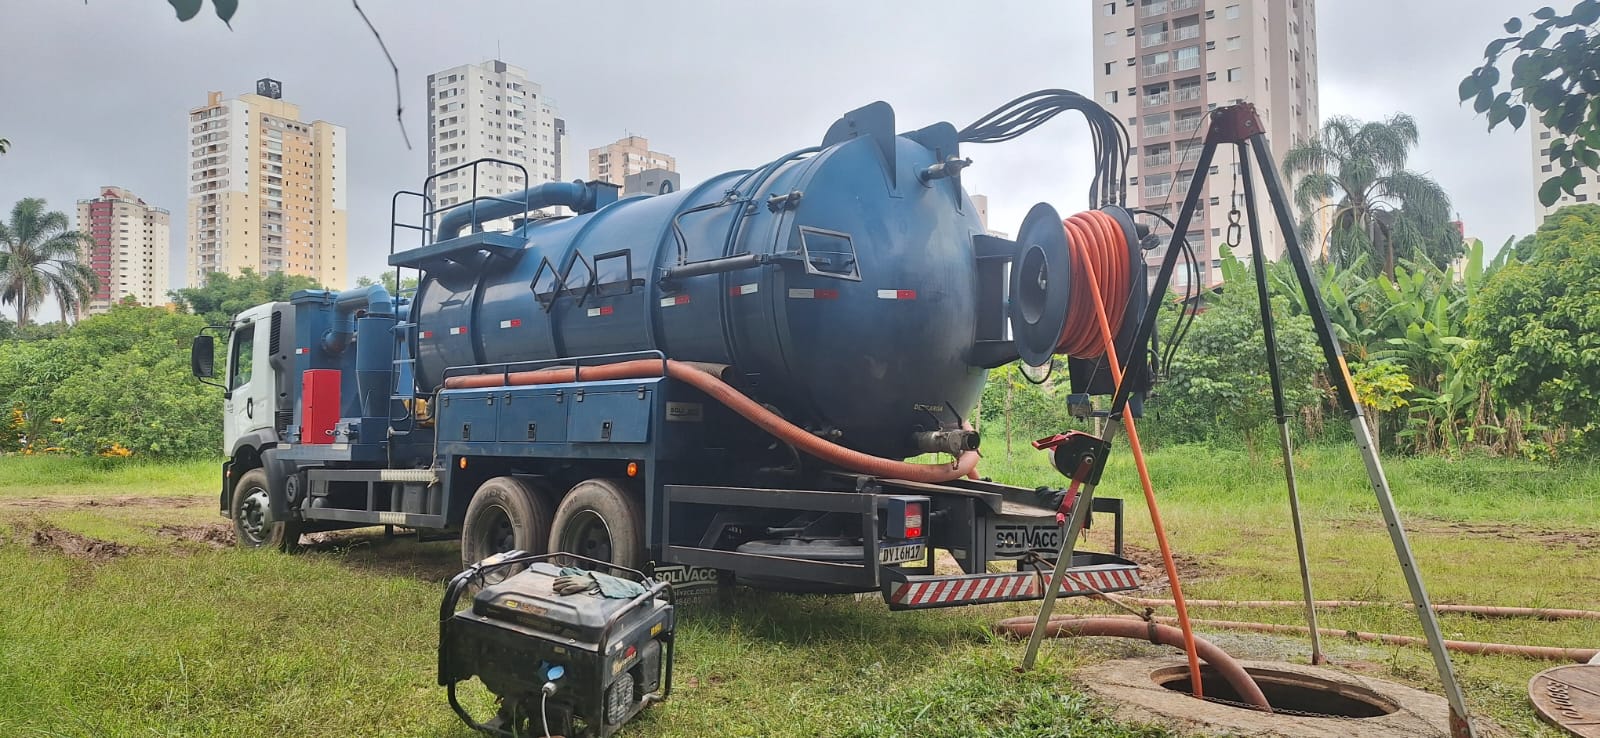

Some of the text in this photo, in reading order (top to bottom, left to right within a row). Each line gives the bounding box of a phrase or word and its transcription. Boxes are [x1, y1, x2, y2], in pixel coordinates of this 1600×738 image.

[996, 527, 1058, 548] SOLIVACC
[883, 545, 920, 562] DYI6H17
[655, 566, 717, 583] SOLIVACC
